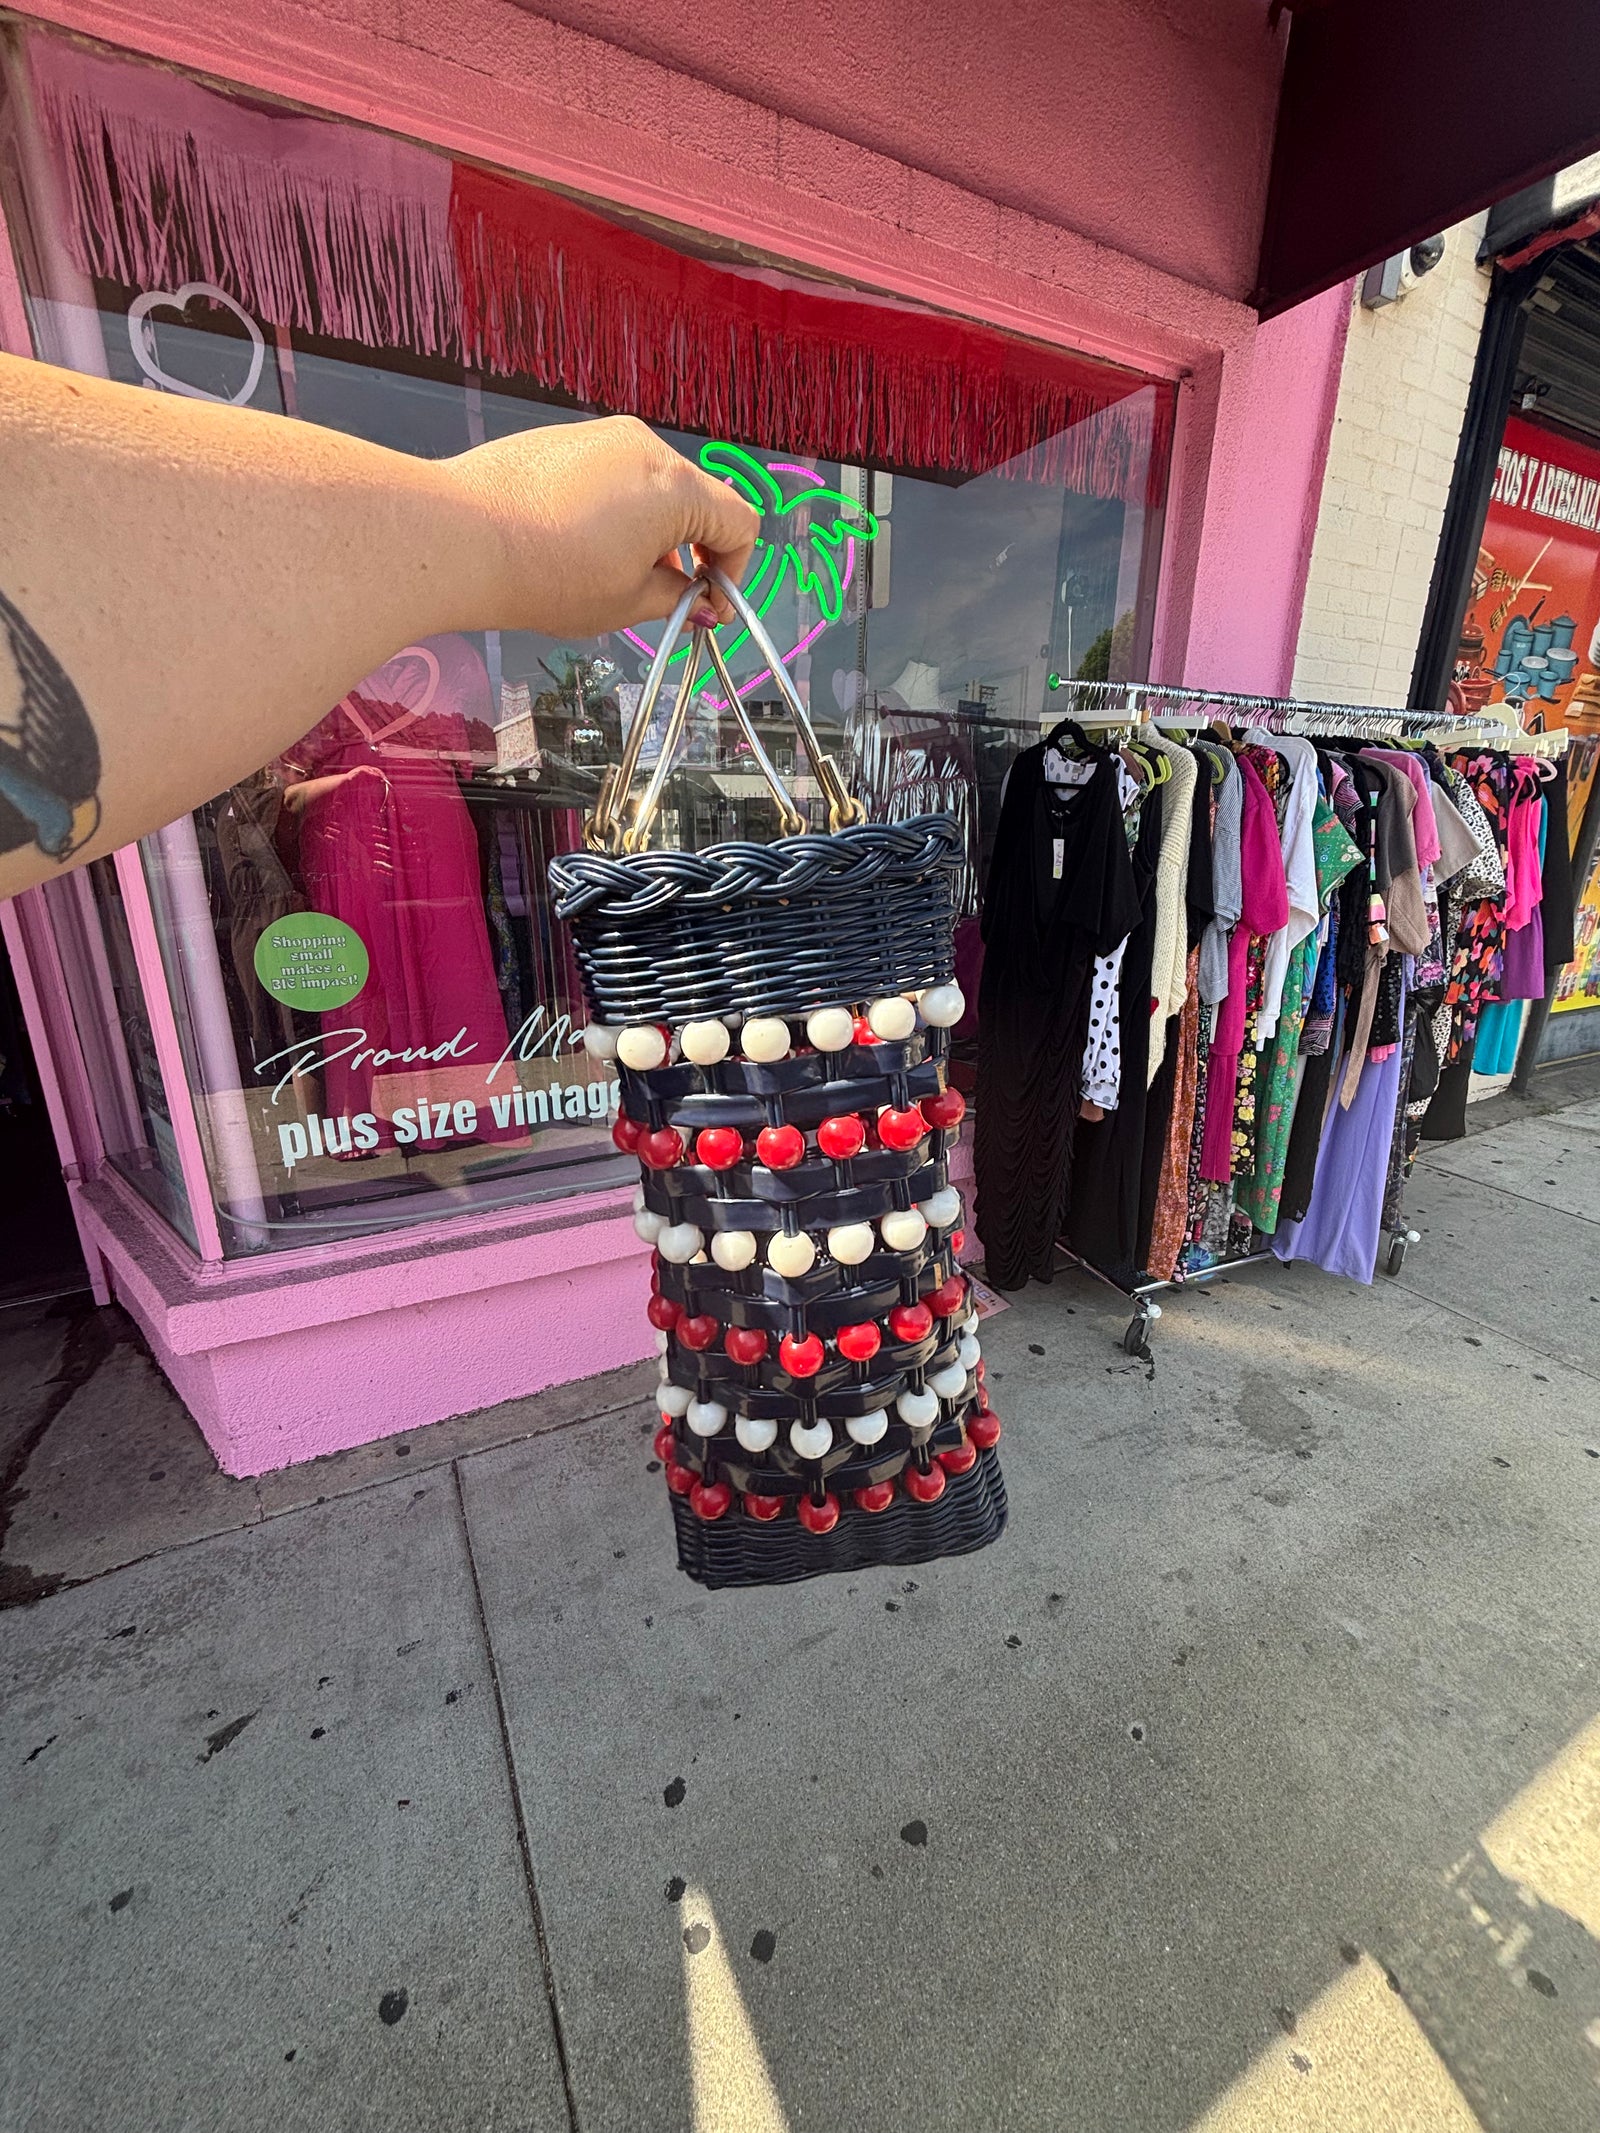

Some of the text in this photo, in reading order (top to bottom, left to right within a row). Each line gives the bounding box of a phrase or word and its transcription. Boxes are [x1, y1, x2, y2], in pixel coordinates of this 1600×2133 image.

[1521, 457, 1539, 510] Y
[1530, 462, 1600, 532] ARTESANIA
[272, 934, 346, 949] Shopping
[290, 948, 333, 961] small
[281, 963, 346, 976] makes a
[271, 974, 358, 990] BIG impact!
[254, 1027, 479, 1105] Proud
[277, 1113, 379, 1168] plus
[392, 1097, 478, 1144] size
